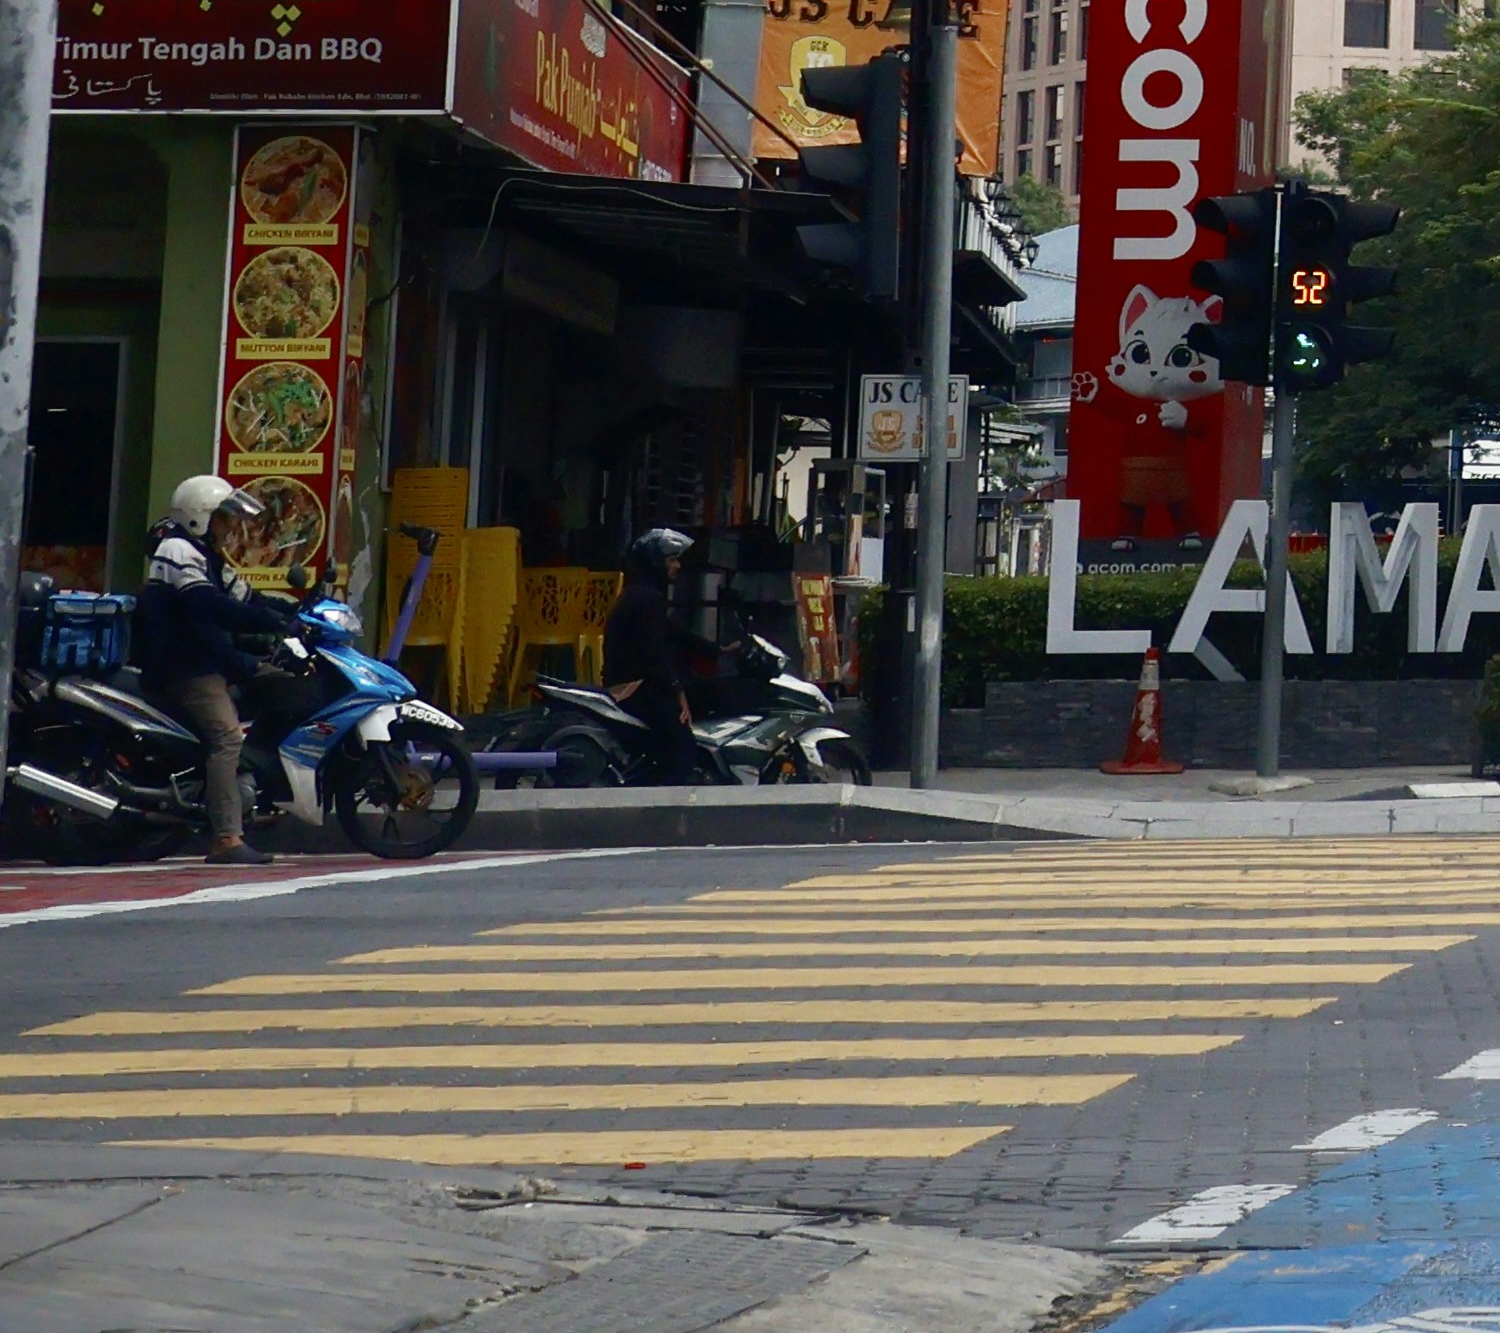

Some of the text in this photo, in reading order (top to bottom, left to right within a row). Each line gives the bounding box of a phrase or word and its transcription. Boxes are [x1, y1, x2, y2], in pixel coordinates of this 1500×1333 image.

[138, 37, 245, 70] Tengah
[254, 37, 312, 60] Dan
[321, 37, 382, 64] BBQ
[1292, 271, 1325, 304] 52
[869, 382, 958, 403] JS CE
